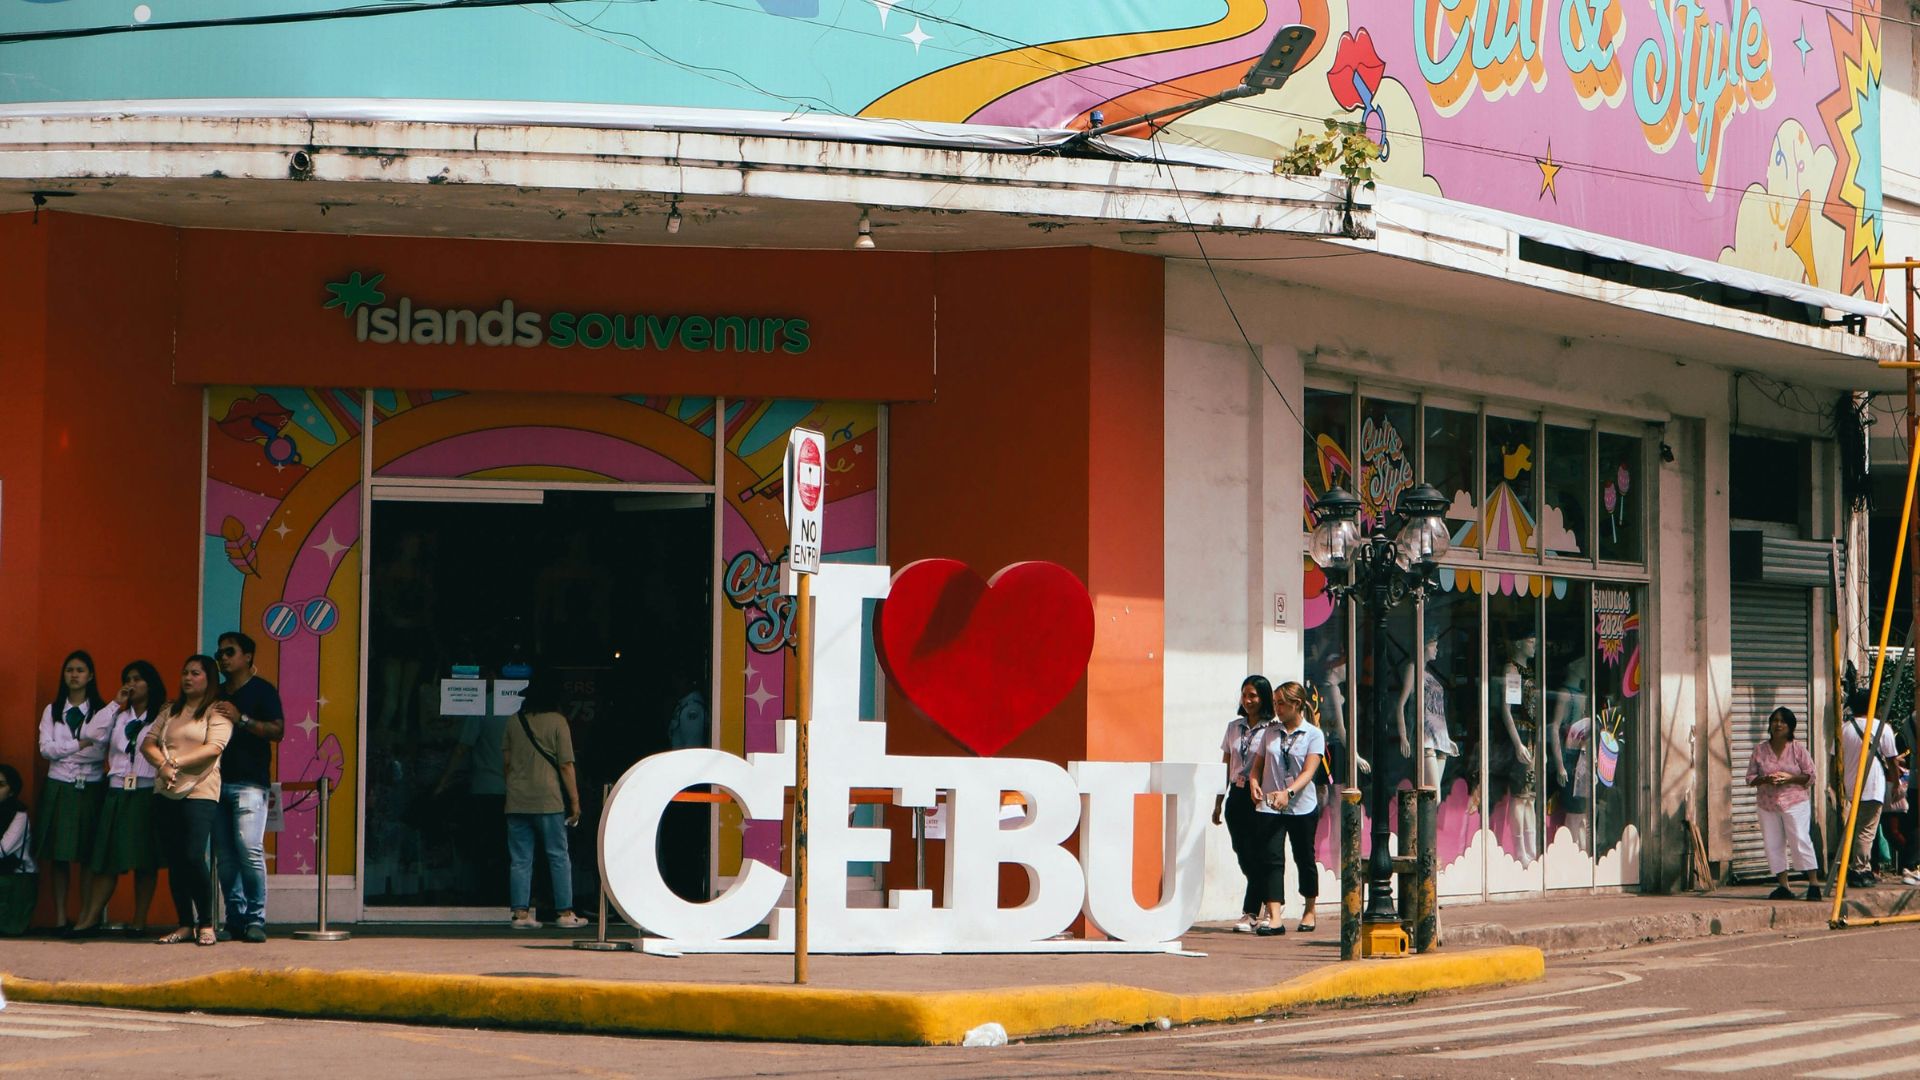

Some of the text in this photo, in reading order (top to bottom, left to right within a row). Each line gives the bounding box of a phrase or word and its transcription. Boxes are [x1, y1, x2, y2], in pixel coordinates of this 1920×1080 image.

[1559, 0, 1620, 92] &
[1632, 0, 1772, 188] Style
[356, 296, 811, 355] islands souvenirs
[1371, 450, 1413, 514] Style
[794, 544, 819, 567] ENTRY
[801, 518, 816, 543] NO
[725, 552, 785, 602] Cu
[1593, 590, 1630, 612] SINULOG
[1600, 614, 1624, 638] 2024
[776, 563, 891, 756] I
[128, 778, 134, 788] 7
[598, 747, 1228, 943] CEBU
